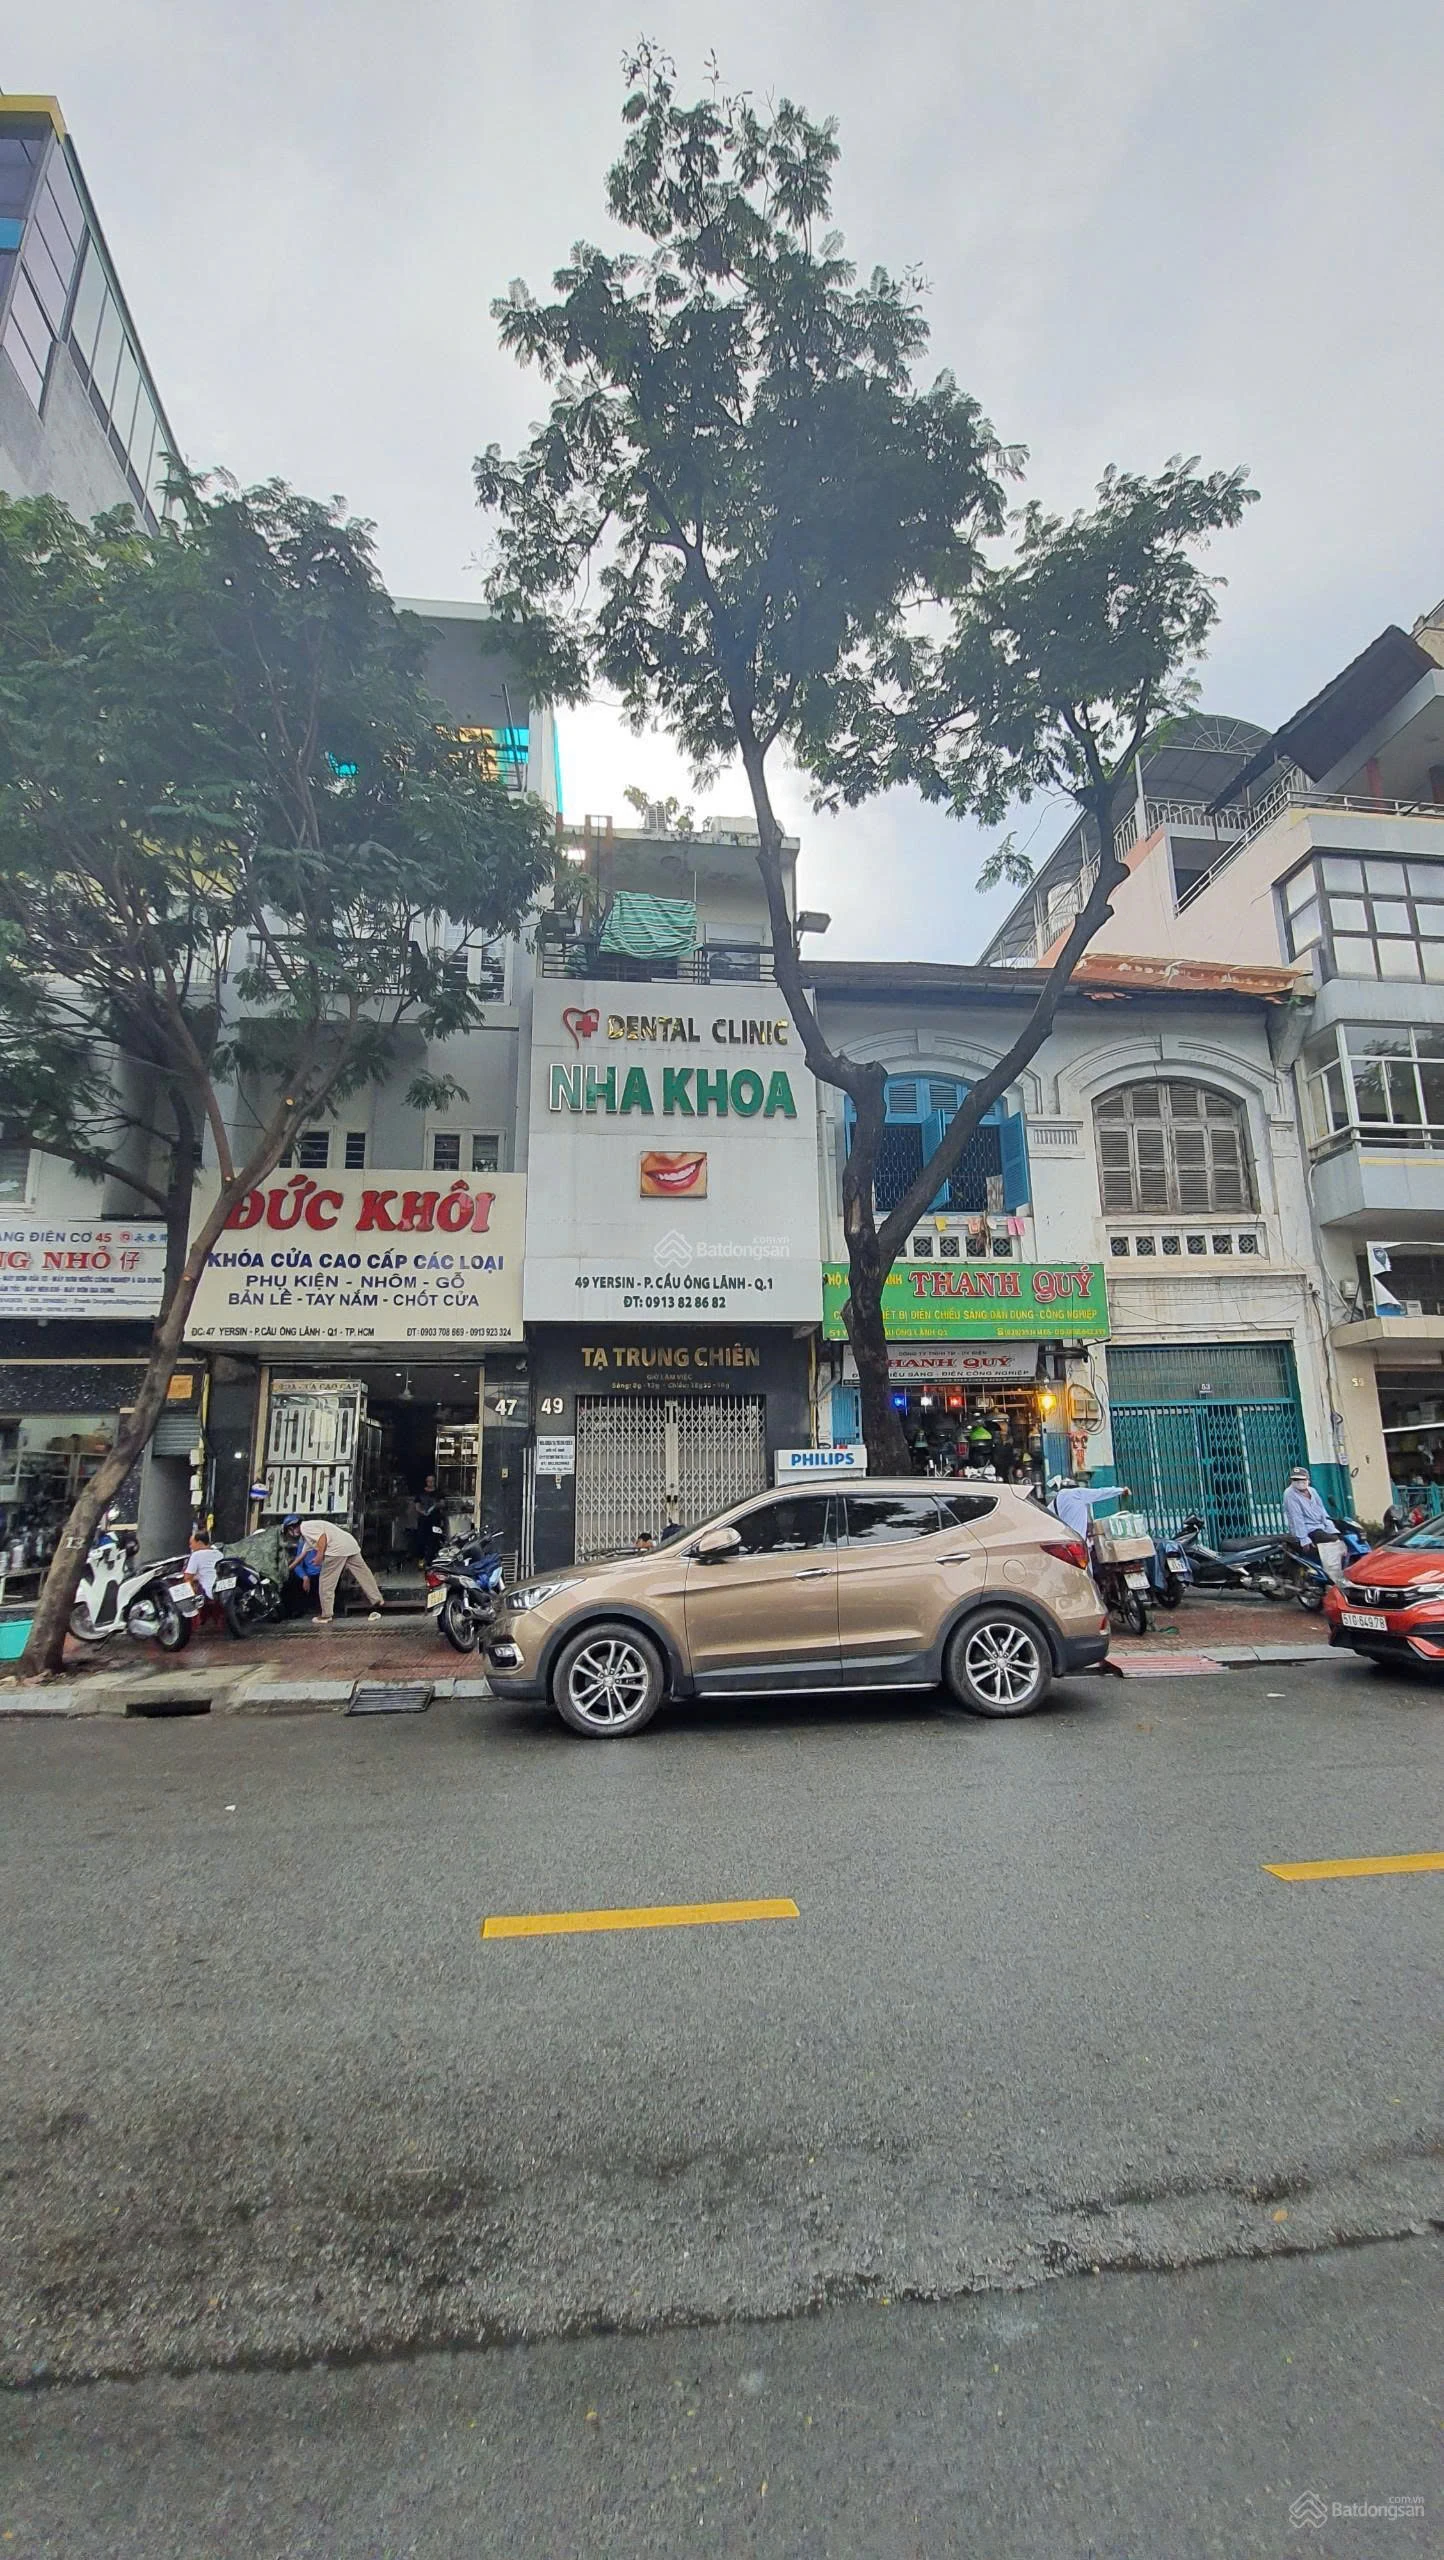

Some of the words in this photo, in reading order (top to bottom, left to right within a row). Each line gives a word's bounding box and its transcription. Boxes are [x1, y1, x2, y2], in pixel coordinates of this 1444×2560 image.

[607, 1014, 701, 1043] DENTAL
[711, 1018, 790, 1046] CLINIC
[549, 1063, 654, 1115] NHA
[662, 1067, 798, 1118] KHOA
[223, 1173, 345, 1231] ĐỨC
[355, 1179, 497, 1233] KHÔI
[0, 1231, 24, 1242] NG
[29, 1230, 66, 1245] ĐIỆN
[70, 1231, 93, 1243] CƠ
[95, 1232, 113, 1243] 45
[42, 1246, 113, 1270] NHỎ
[119, 1251, 141, 1271] 仔
[207, 1249, 264, 1268] KHÓA
[271, 1248, 313, 1268] CỬA
[319, 1253, 362, 1268] CAO
[367, 1248, 407, 1269] CẤP
[413, 1251, 454, 1270] CÁC
[459, 1255, 504, 1274] LOẠI
[246, 1275, 287, 1290] PHỤ
[294, 1273, 339, 1291] KIỆN
[361, 1274, 417, 1288] NHÔM
[436, 1272, 465, 1289] GỖ
[575, 1277, 590, 1288] 49
[592, 1277, 635, 1289] YERSIN
[644, 1277, 653, 1289] P.
[683, 1275, 710, 1290] ÔNG
[754, 1279, 773, 1291] Q.1
[908, 1271, 1022, 1297] THANH
[1032, 1265, 1094, 1303] QUÝ
[228, 1290, 264, 1305] BẢN
[305, 1293, 335, 1306] TAY
[339, 1290, 379, 1306] NẮM
[393, 1290, 438, 1306] CHỐT
[443, 1292, 479, 1306] CỬA
[624, 1296, 643, 1308] ĐT:
[645, 1296, 675, 1308] 0913
[678, 1296, 692, 1308] 82
[694, 1296, 709, 1308] 86
[711, 1296, 726, 1308] 82
[219, 1328, 247, 1336] YERSIN
[358, 1328, 375, 1336] HCM
[420, 1328, 437, 1336] 0903
[438, 1328, 450, 1336] 708
[470, 1328, 485, 1336] 0913
[486, 1328, 498, 1336] 923
[499, 1328, 512, 1336] 324
[582, 1348, 609, 1371] TẠ
[613, 1348, 689, 1367] TRUNG
[888, 1358, 955, 1368] HANH
[495, 1399, 518, 1416] 47
[541, 1397, 564, 1415] 49
[791, 1452, 855, 1466] PHILIPS
